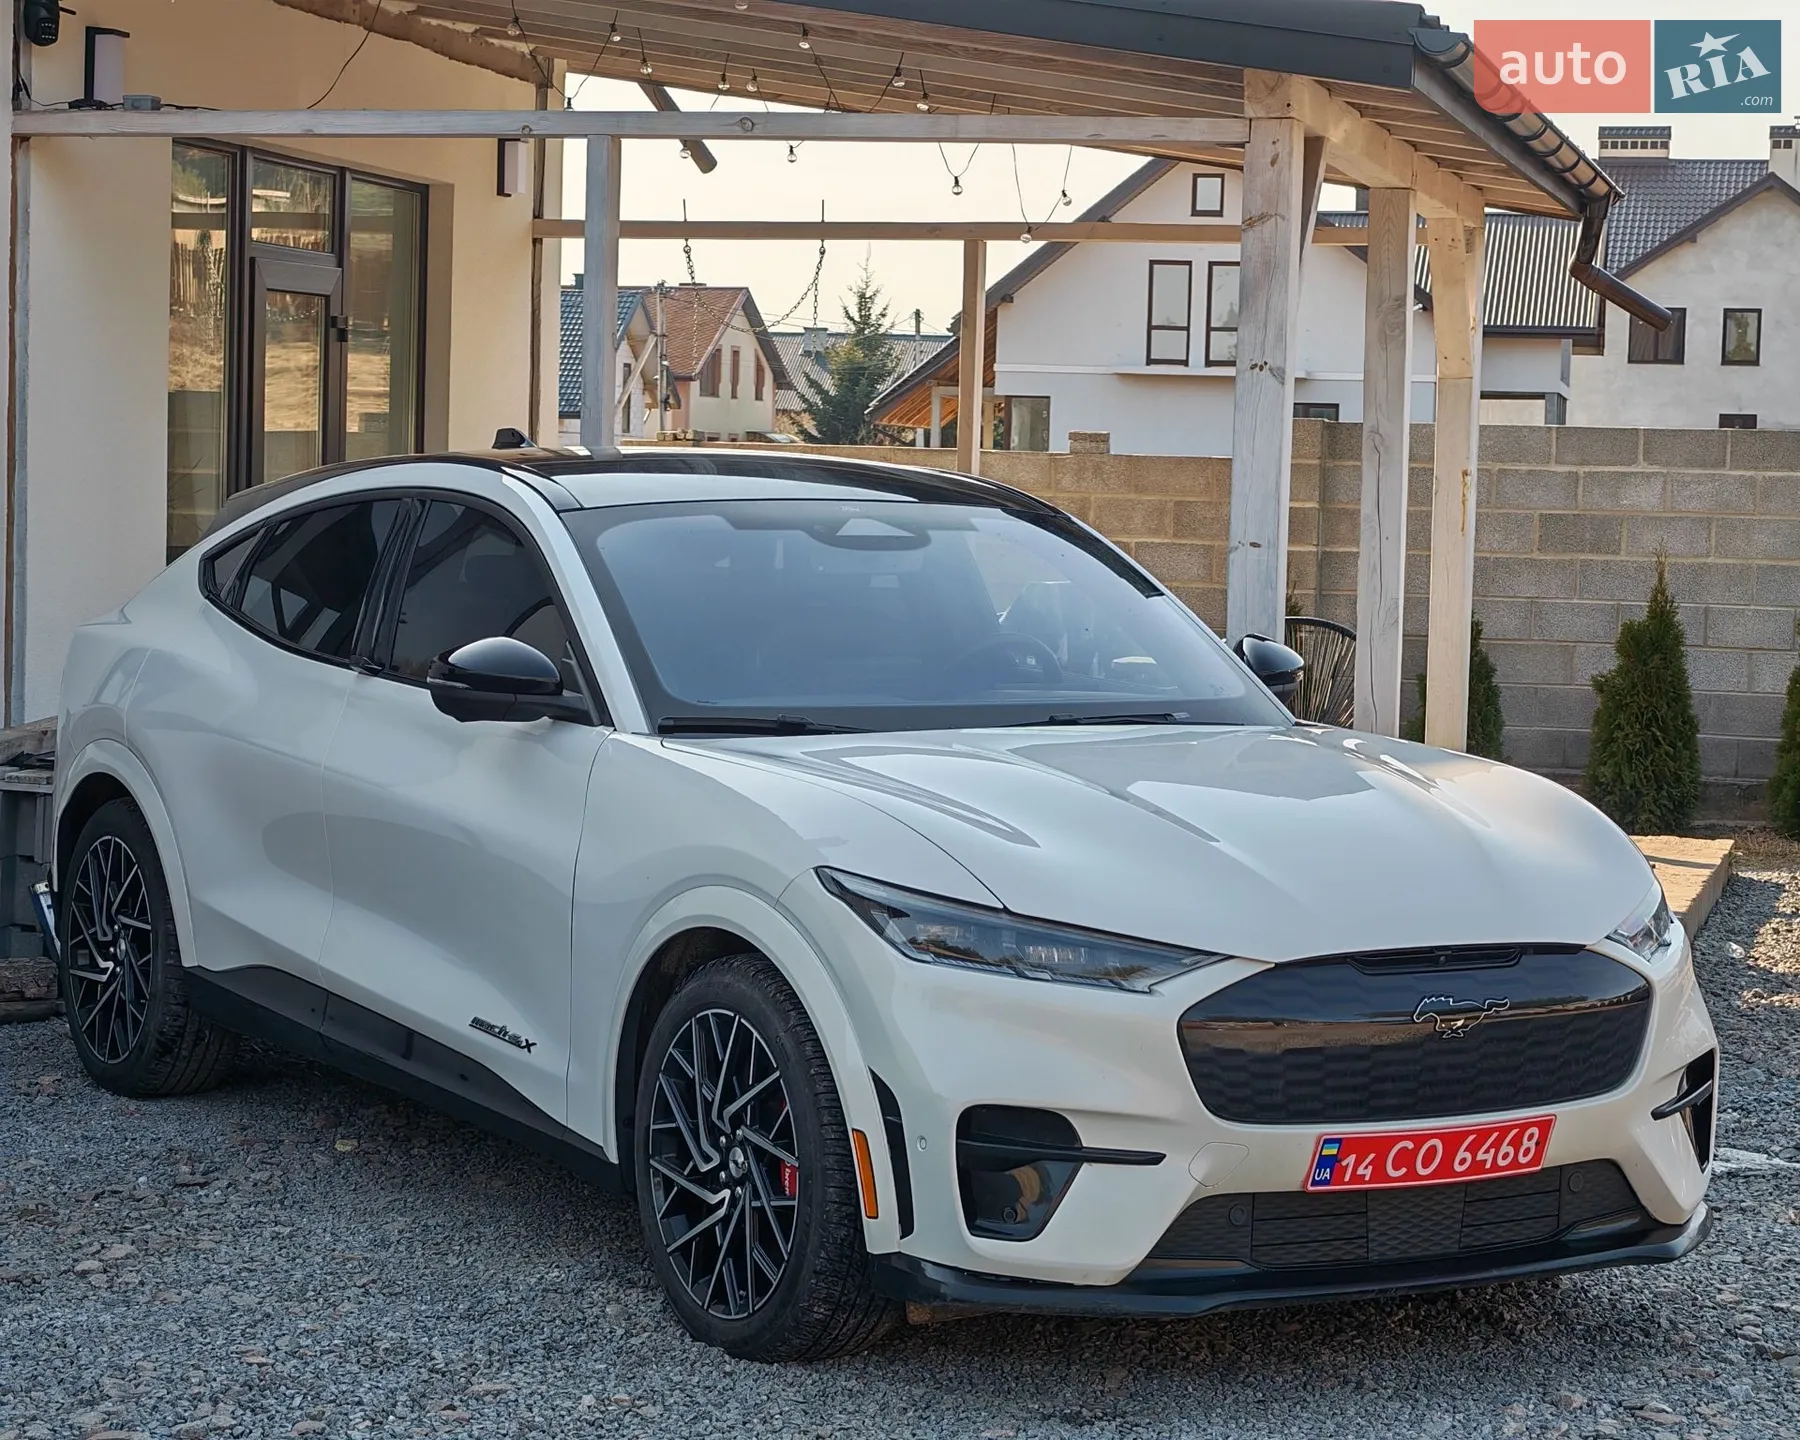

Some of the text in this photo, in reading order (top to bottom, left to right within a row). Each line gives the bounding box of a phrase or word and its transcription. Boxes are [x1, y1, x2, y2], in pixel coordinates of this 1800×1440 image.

[1340, 1126, 1540, 1182] 14 CO 6468
[1314, 1167, 1331, 1181] UA
